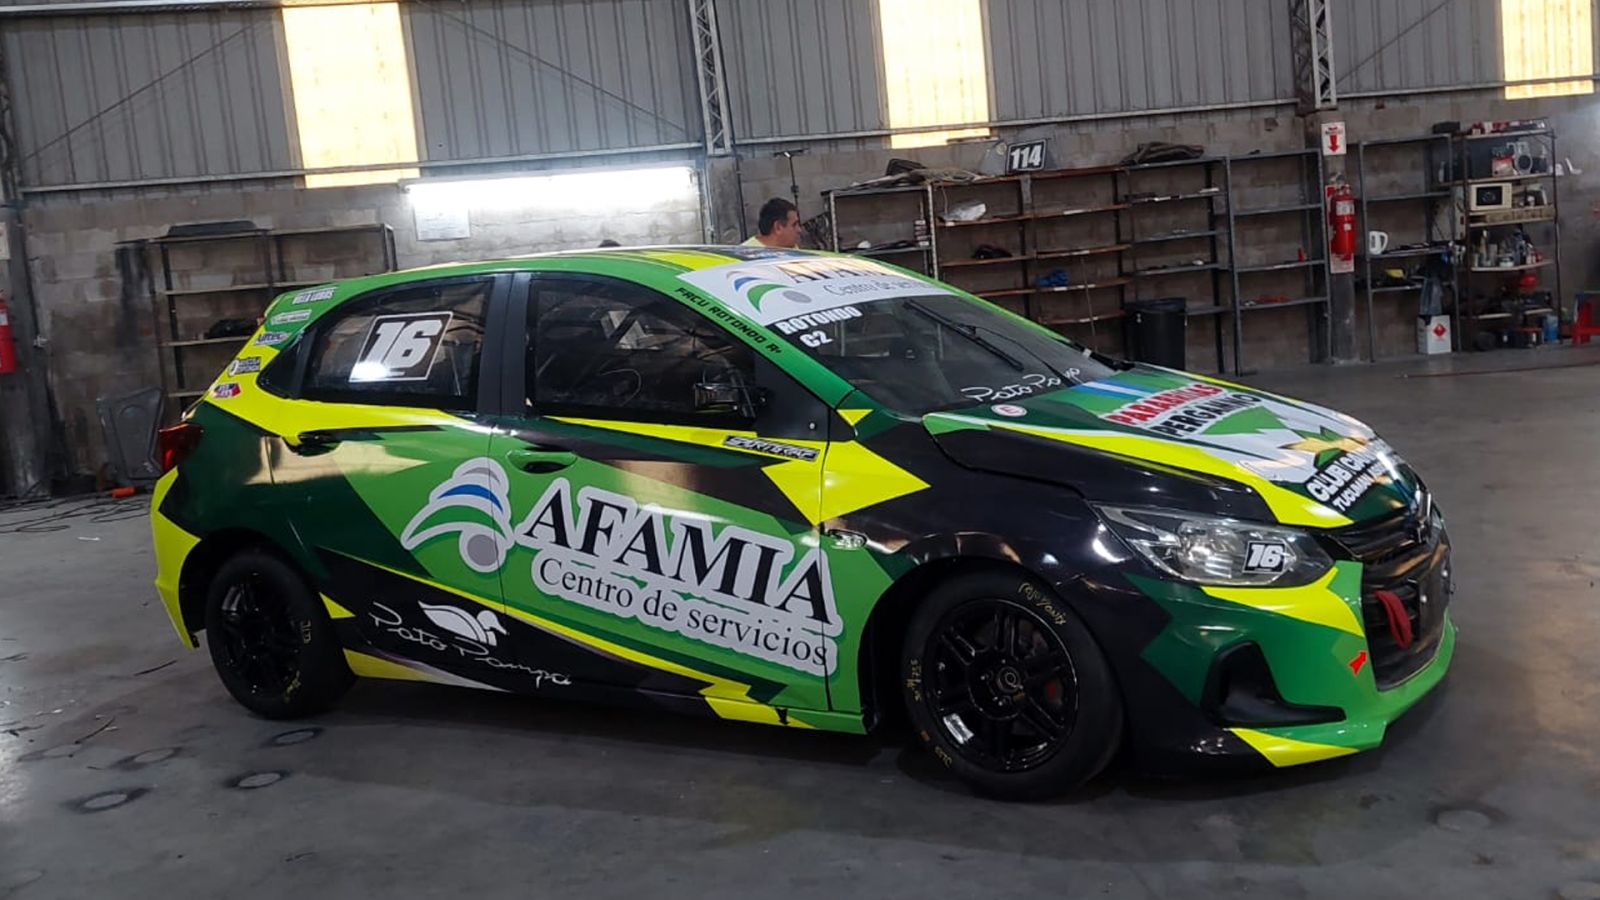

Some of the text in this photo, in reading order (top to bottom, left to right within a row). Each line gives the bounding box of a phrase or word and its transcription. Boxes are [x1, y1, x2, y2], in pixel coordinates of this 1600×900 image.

[1010, 145, 1042, 169] 114
[708, 306, 767, 343] ROTONDO
[775, 306, 863, 335] ROTONDO
[358, 319, 443, 369] 16
[800, 331, 833, 349] C2
[1306, 463, 1353, 502] CLUB
[522, 487, 834, 625] AFAMIA
[1248, 543, 1284, 568] 16
[539, 557, 829, 667] Centro de servicios
[368, 601, 448, 651] Pato
[452, 635, 572, 689] Pampa
